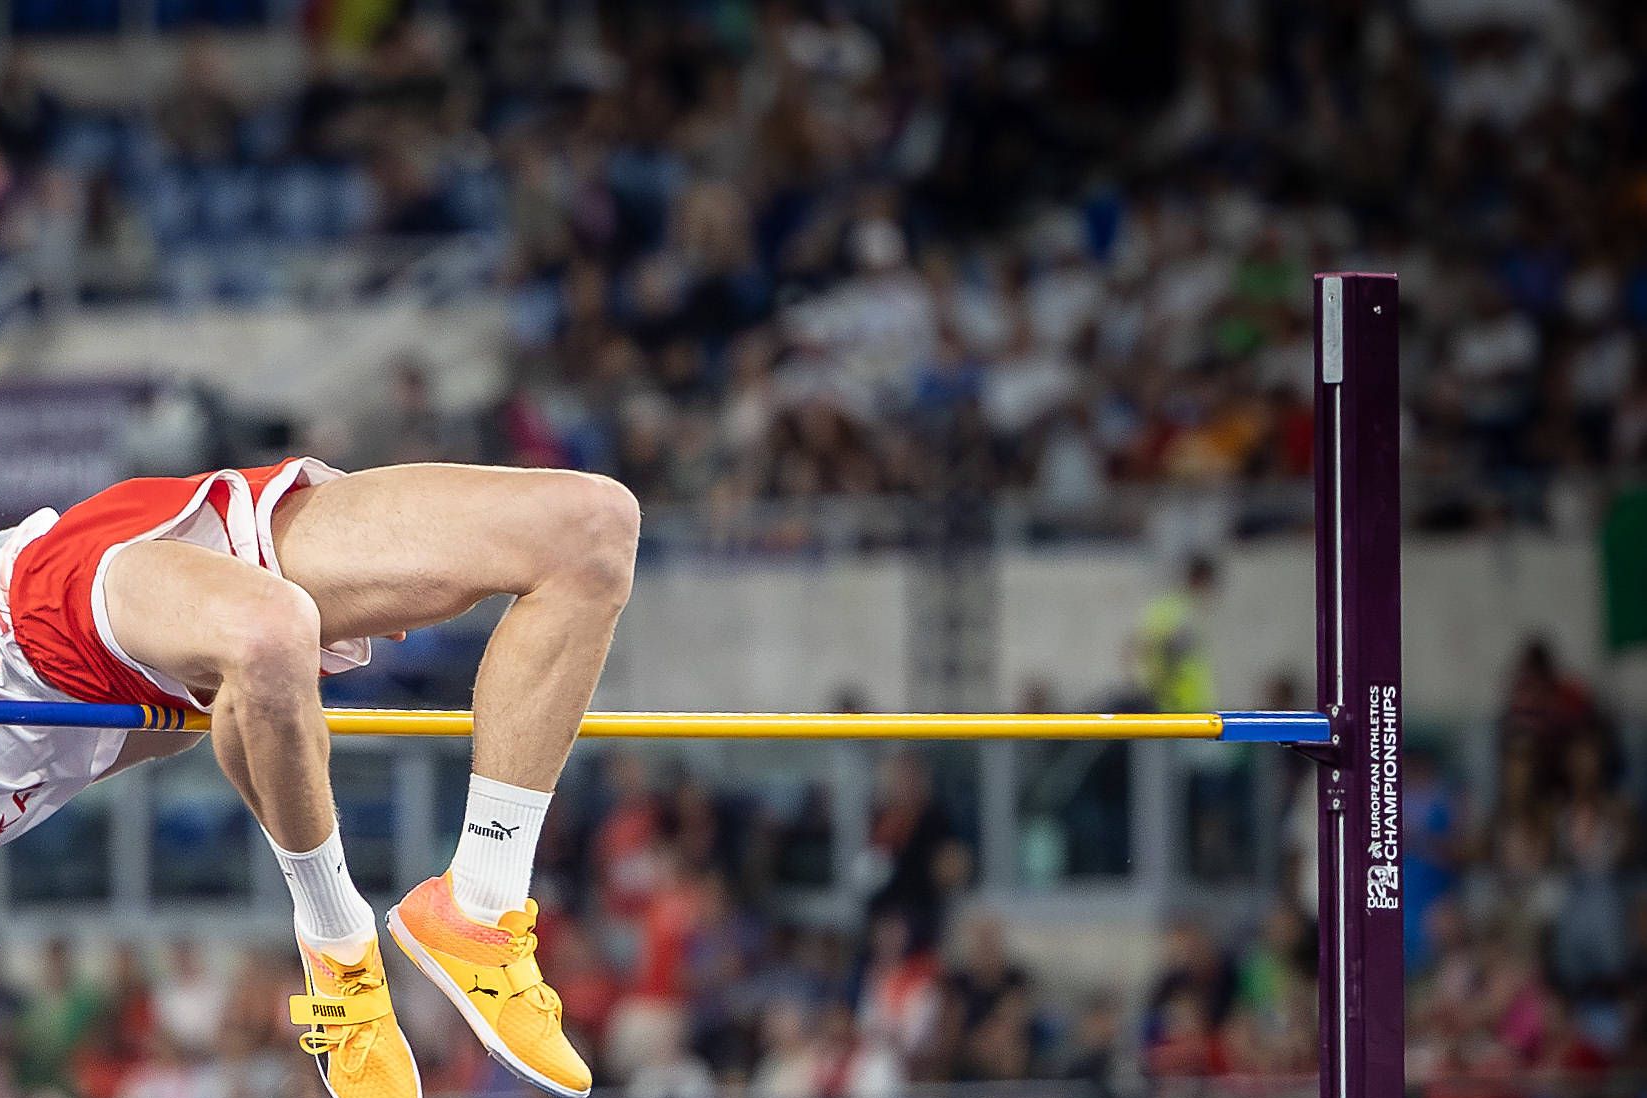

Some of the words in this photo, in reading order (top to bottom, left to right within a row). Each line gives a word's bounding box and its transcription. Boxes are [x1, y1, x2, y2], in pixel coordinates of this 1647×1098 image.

[1369, 685, 1380, 761] ATHLETICS
[1370, 764, 1381, 838] EUROPEAN
[1383, 686, 1398, 860] CHAMPIONSHIPS
[467, 823, 505, 841] PUMA
[312, 1004, 347, 1018] PUMA
